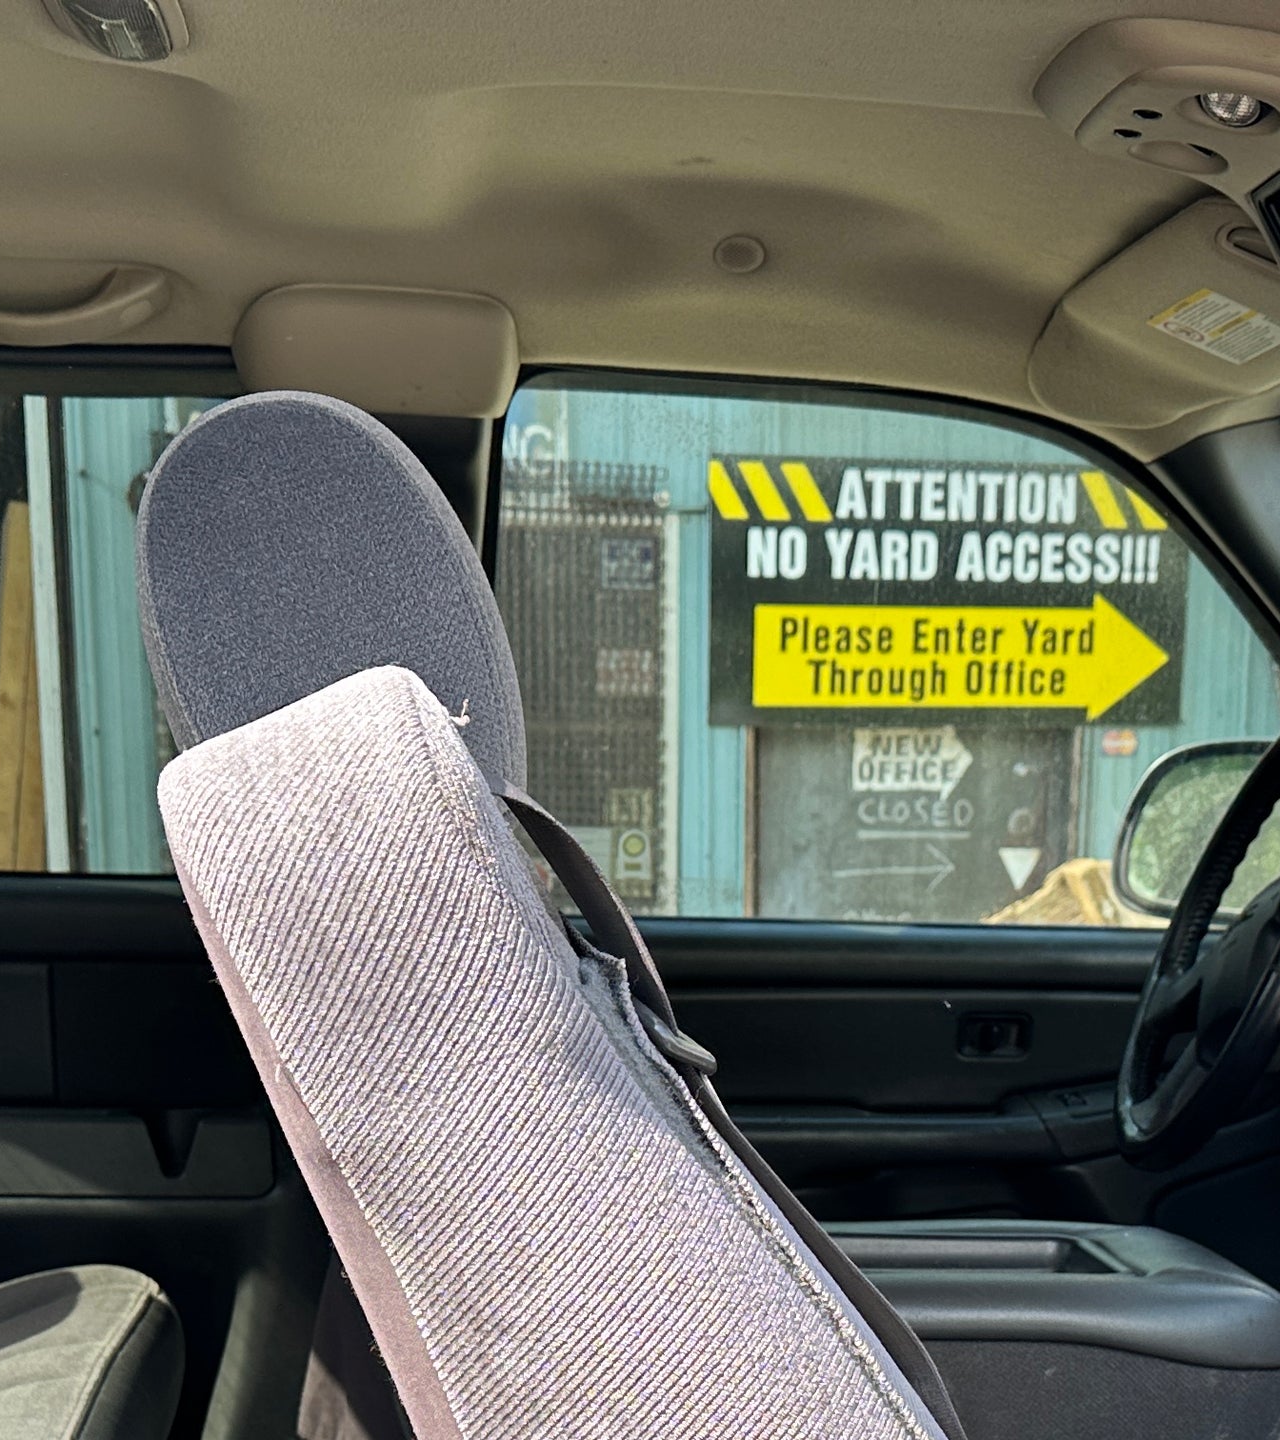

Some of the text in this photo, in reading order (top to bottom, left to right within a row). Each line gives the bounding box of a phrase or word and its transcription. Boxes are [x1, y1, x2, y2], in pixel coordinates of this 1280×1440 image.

[835, 467, 1077, 525] ATTENTION
[746, 526, 1161, 584] NO YARD ACCESS!!!
[780, 617, 1094, 656] Please Enter Yard
[808, 659, 1066, 702] Through Office
[869, 734, 942, 757] NEW
[858, 757, 957, 784] OFFICE
[858, 797, 974, 827] CLOSED
